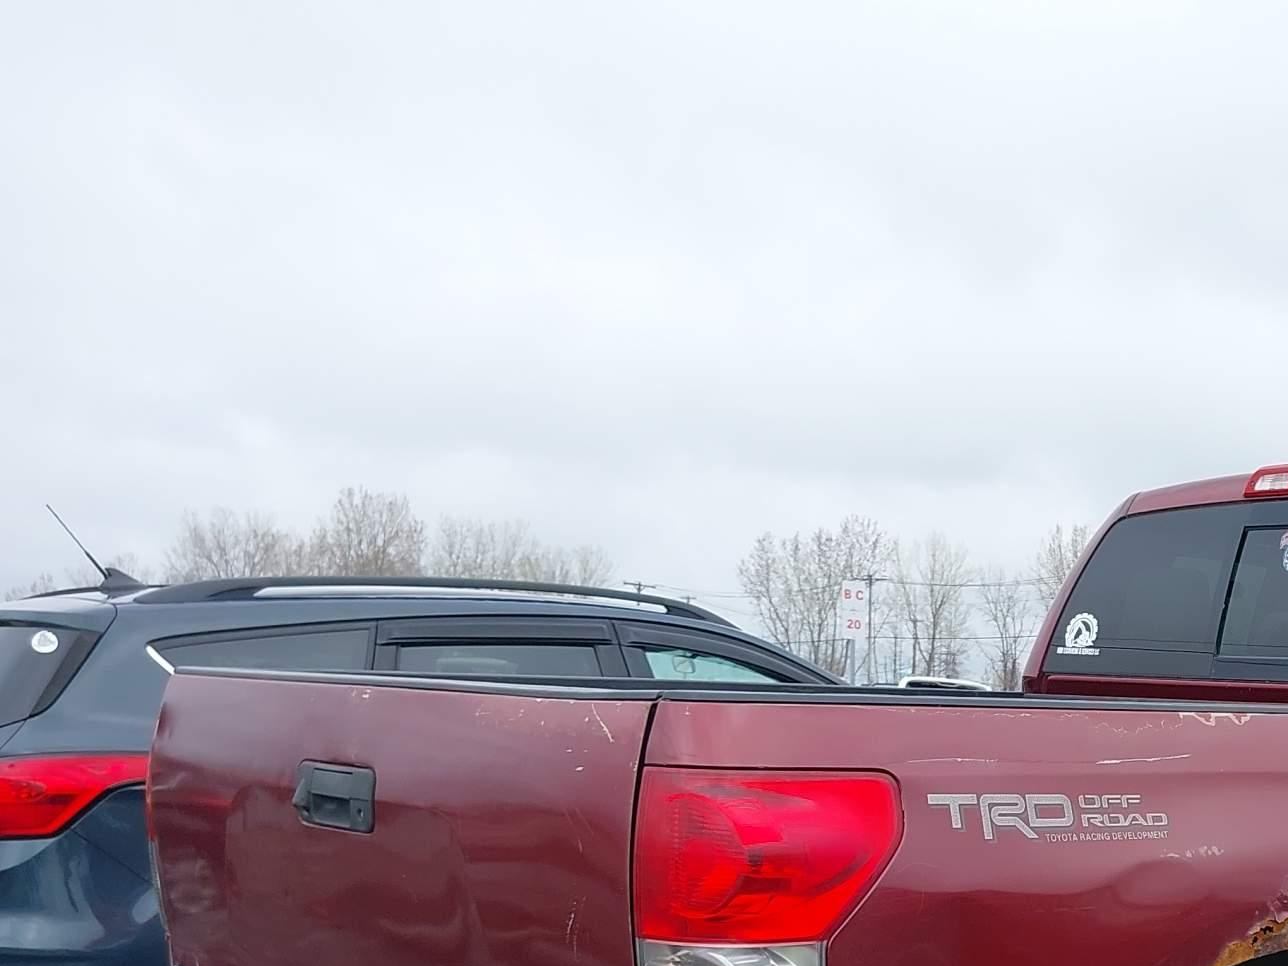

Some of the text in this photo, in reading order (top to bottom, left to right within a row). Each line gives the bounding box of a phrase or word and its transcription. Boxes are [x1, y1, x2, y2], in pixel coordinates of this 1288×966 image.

[847, 619, 861, 630] 20
[1078, 794, 1141, 809] OFF
[927, 794, 1074, 840] TRD
[1080, 813, 1169, 827] ROAD
[1045, 831, 1169, 843] TOYOTA RACING DEVELOPMENT
